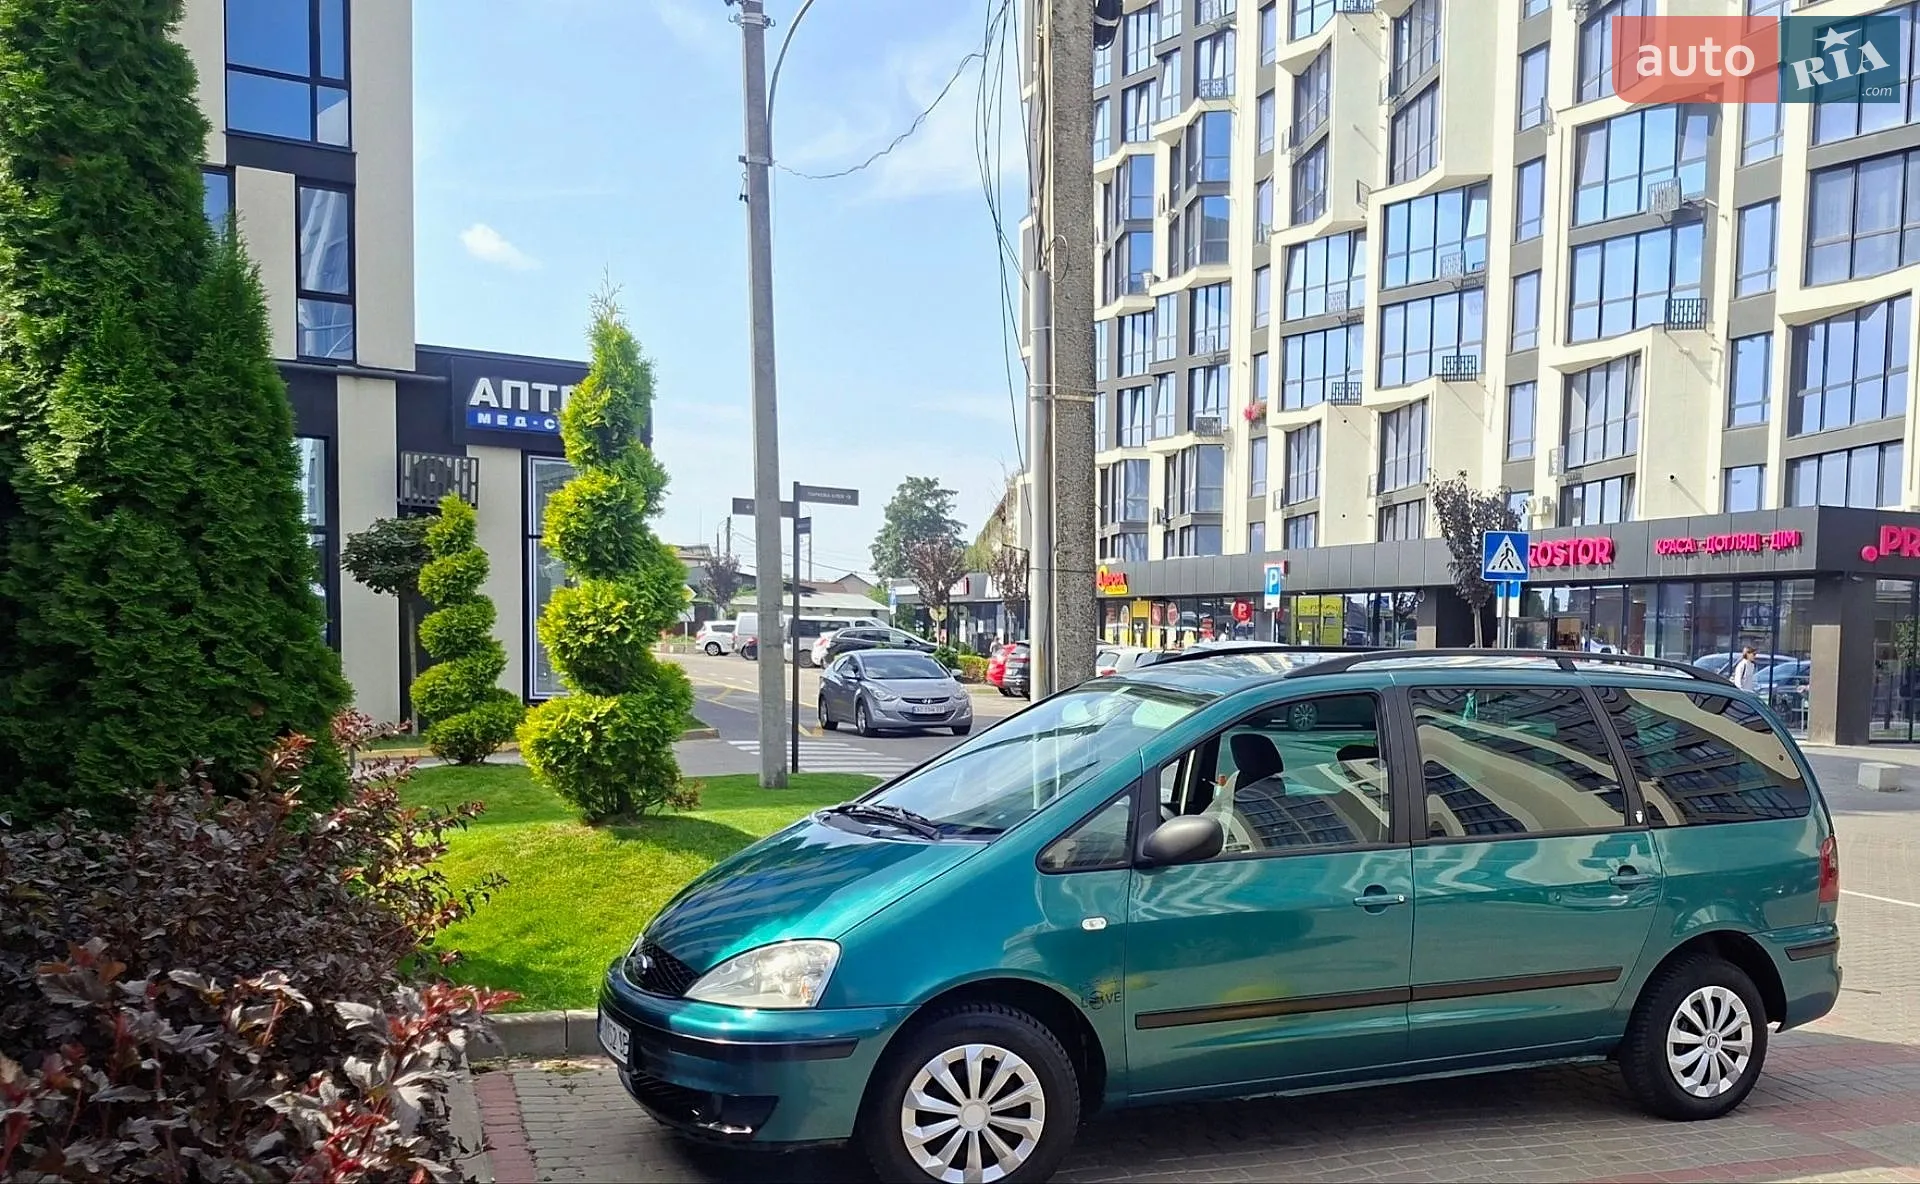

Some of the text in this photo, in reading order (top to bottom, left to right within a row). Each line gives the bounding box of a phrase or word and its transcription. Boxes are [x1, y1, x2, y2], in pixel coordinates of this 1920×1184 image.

[1655, 530, 1801, 554] КРАСА ДОГЛЯД ДІМ
[1269, 568, 1278, 593] P
